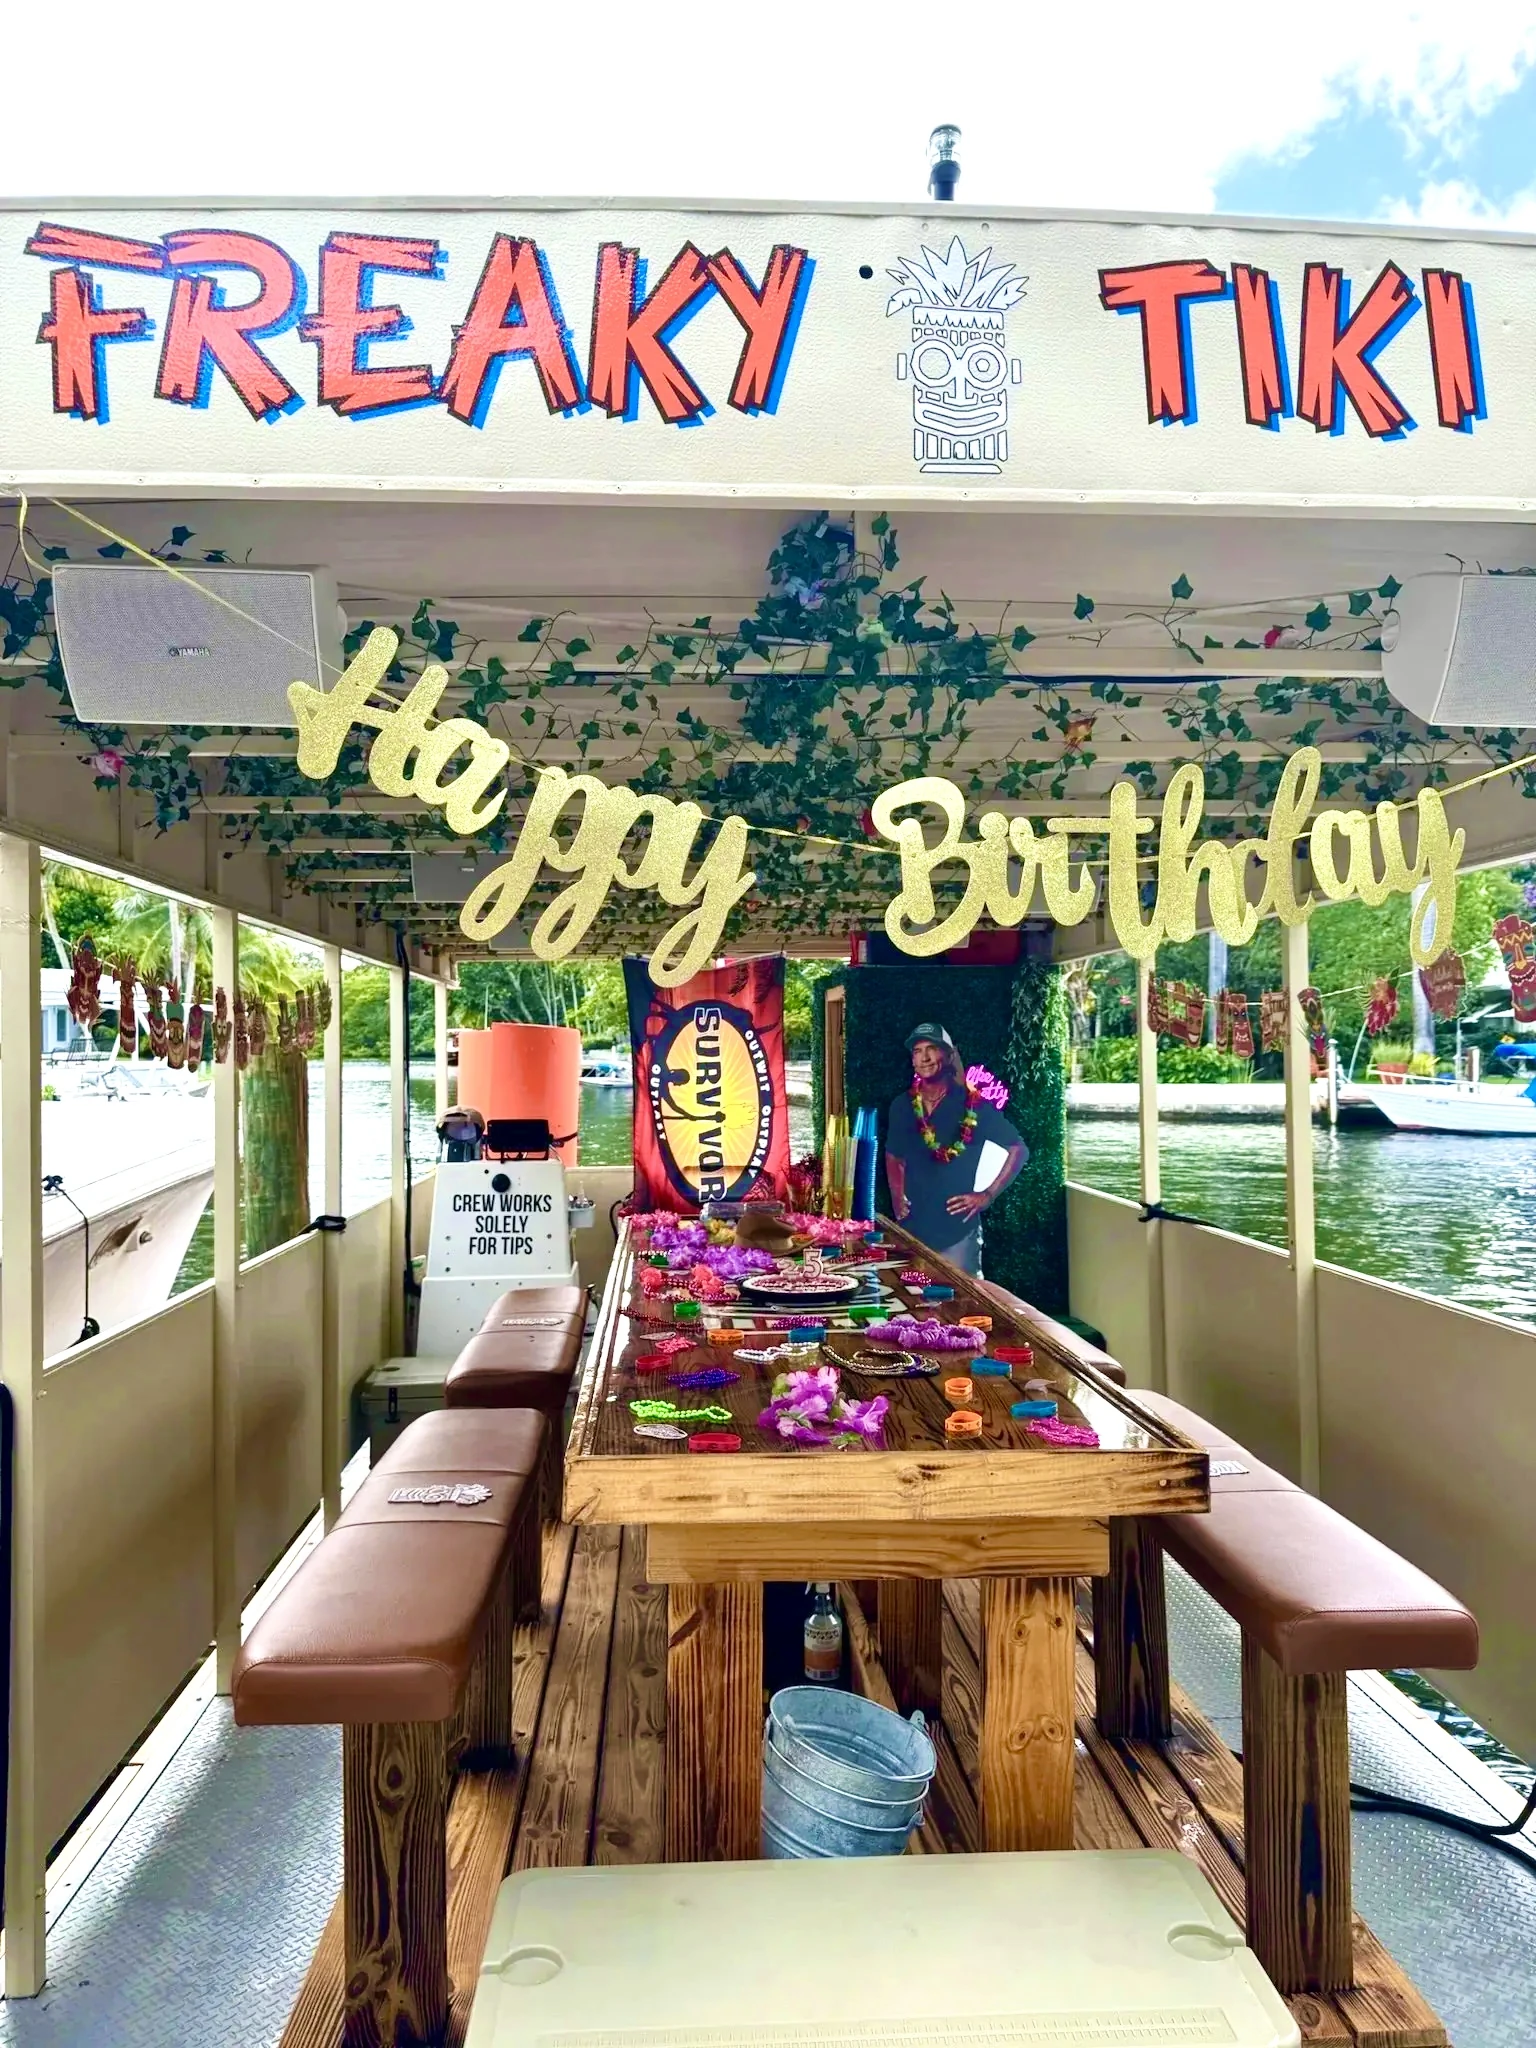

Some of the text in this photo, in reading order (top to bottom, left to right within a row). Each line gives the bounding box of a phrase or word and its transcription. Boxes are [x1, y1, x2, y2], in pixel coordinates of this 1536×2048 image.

[24, 221, 1489, 441] FREAKY TIKI
[177, 646, 211, 657] YAMAHA
[286, 626, 1465, 989] Happy Birthday
[650, 1063, 667, 1140] OUTLAST
[694, 1007, 729, 1203] SURVIVOR
[744, 1029, 772, 1179] OUTWIT OUTPLAY
[452, 1194, 552, 1212] CREW WORKS
[475, 1215, 529, 1233] SOLELY
[469, 1236, 533, 1255] FOR TIPS
